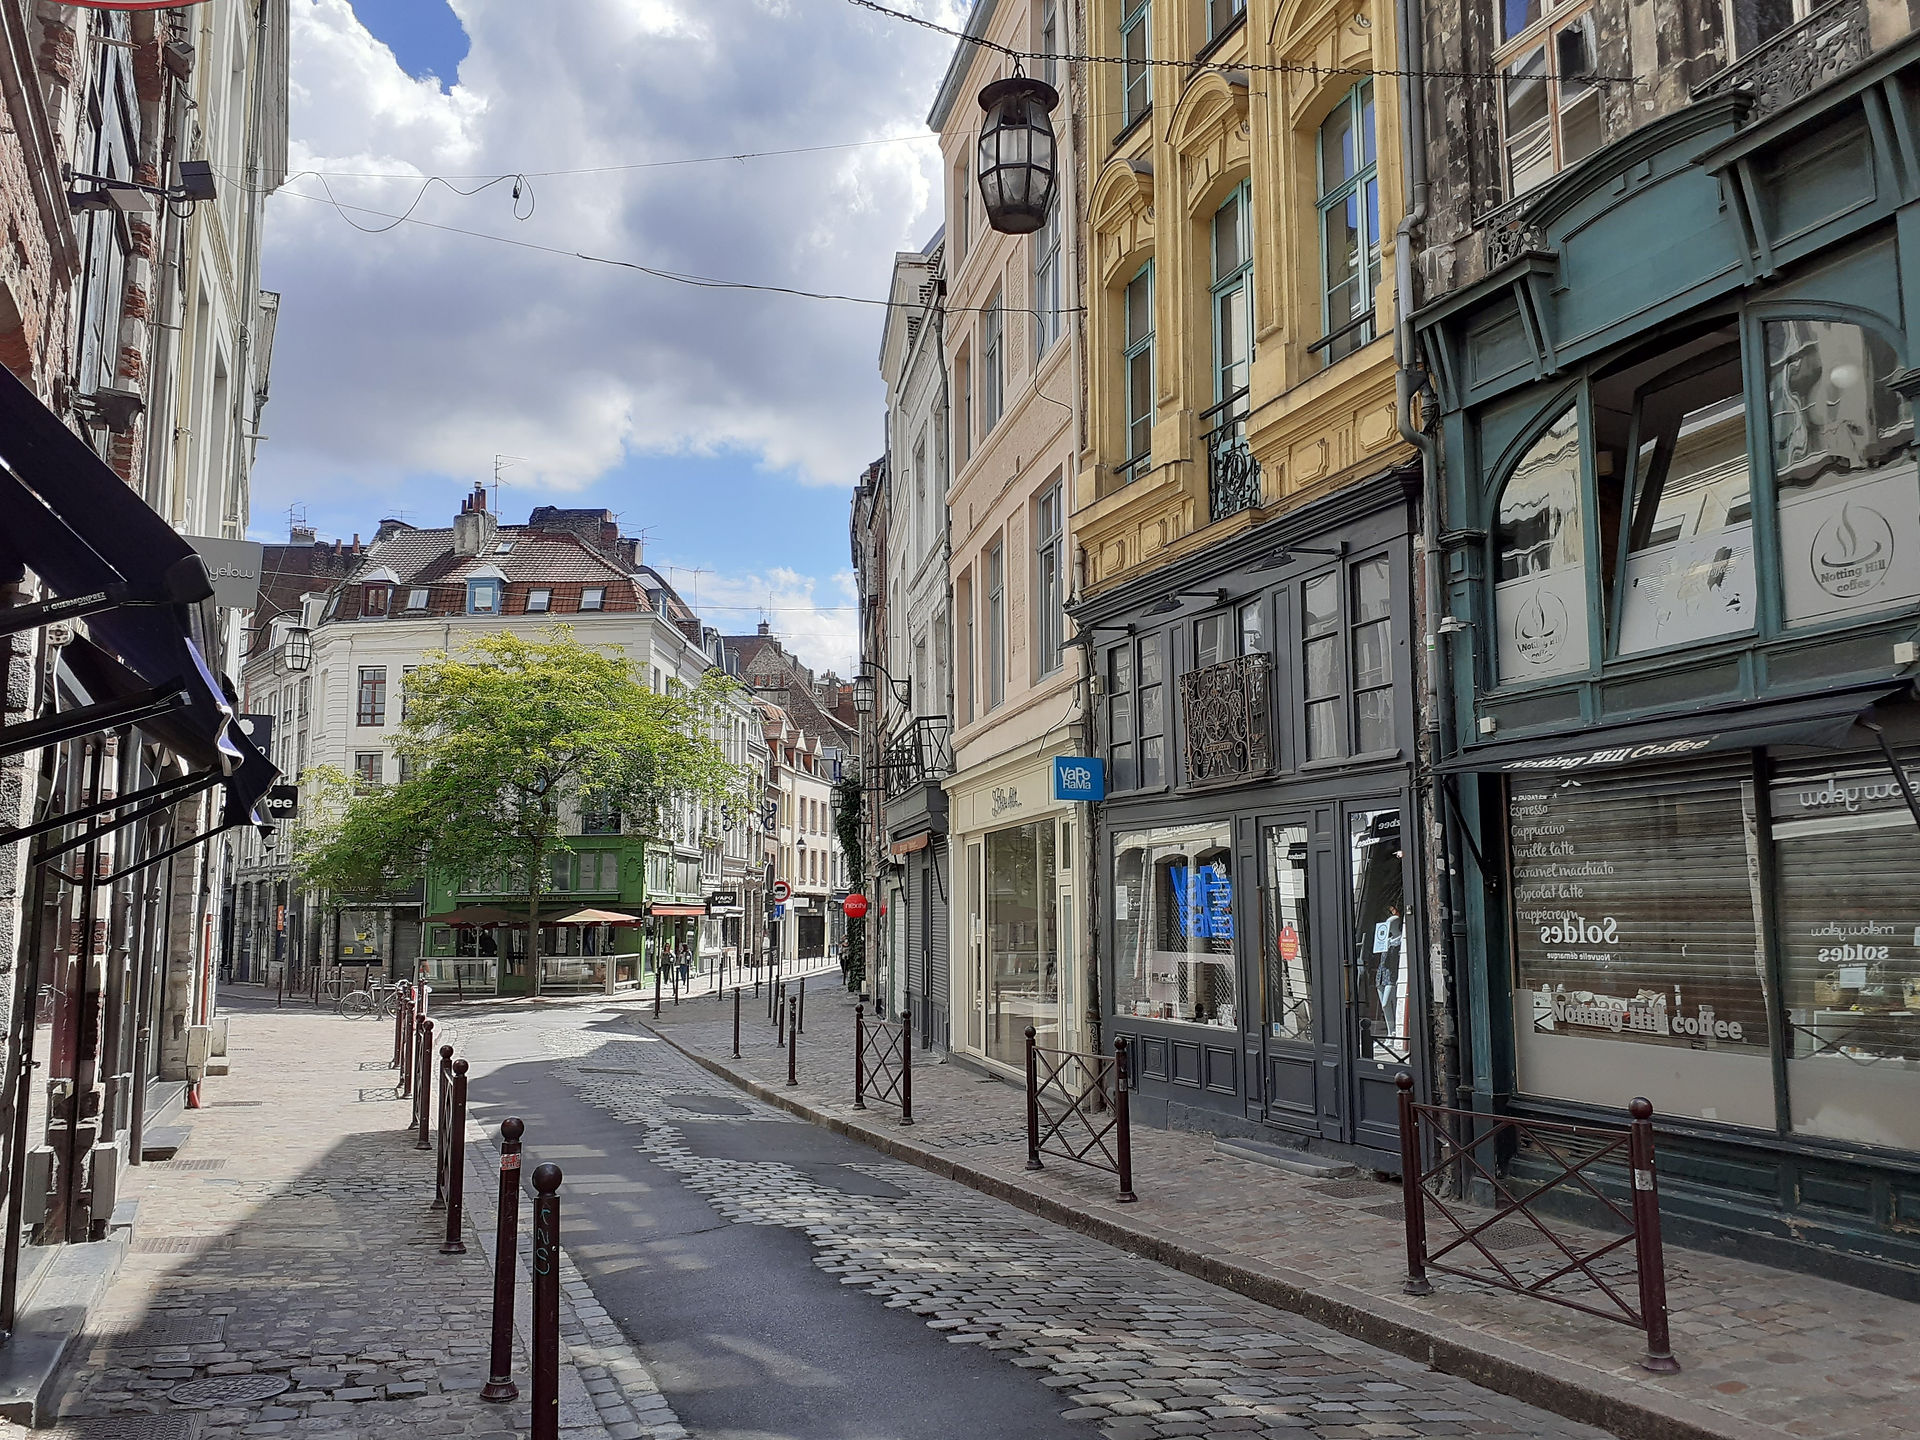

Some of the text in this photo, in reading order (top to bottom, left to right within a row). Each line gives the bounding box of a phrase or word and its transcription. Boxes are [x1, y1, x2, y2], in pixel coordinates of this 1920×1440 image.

[209, 562, 255, 581] yellow
[1820, 559, 1886, 583] Notting Hill
[1836, 579, 1871, 592] coffee
[50, 591, 106, 611] GUERMONPREZ
[1502, 738, 1711, 770] Notting Hill Coffee
[1059, 766, 1091, 781] VaPo
[1510, 803, 1548, 820] Espresso
[1511, 822, 1565, 840] Cappuccino
[1511, 841, 1575, 858] Vanille latte
[1513, 861, 1614, 879] Caramel macchiato
[1514, 885, 1584, 902] Chocolat latte
[1551, 1001, 1743, 1040] Notting Hill coffee
